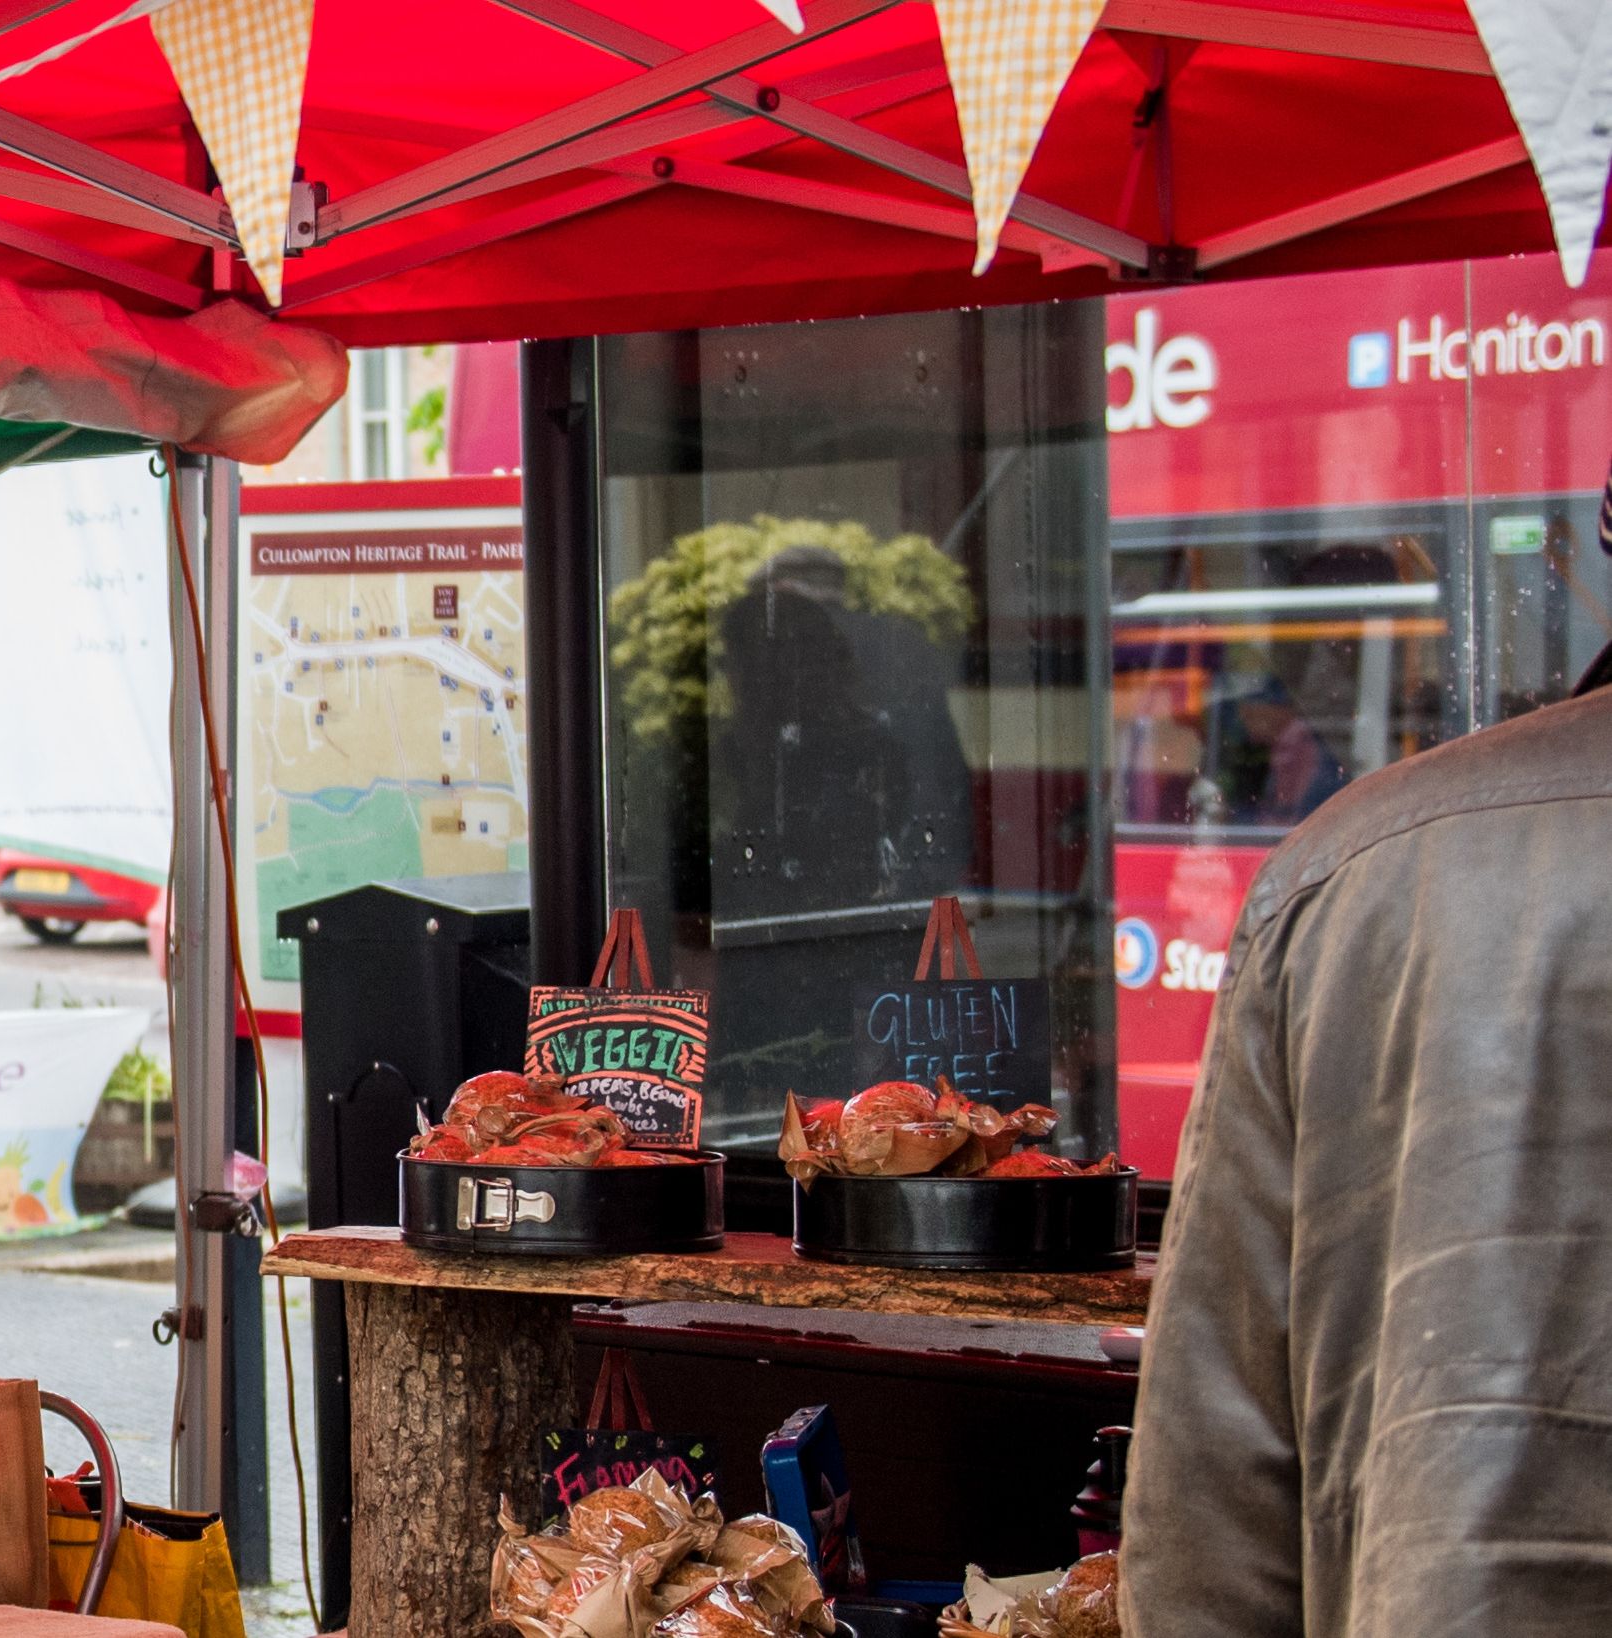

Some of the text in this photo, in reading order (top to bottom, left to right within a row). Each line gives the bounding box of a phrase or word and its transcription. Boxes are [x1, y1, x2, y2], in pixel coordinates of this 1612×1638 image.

[1105, 309, 1214, 432] de
[1397, 311, 1604, 384] Honiton
[258, 547, 352, 564] CULLOMPTON
[355, 546, 424, 562] HERITAGE
[428, 543, 469, 561] TRAIL
[1160, 939, 1225, 992] Sta
[867, 983, 1018, 1062] GLUTEN
